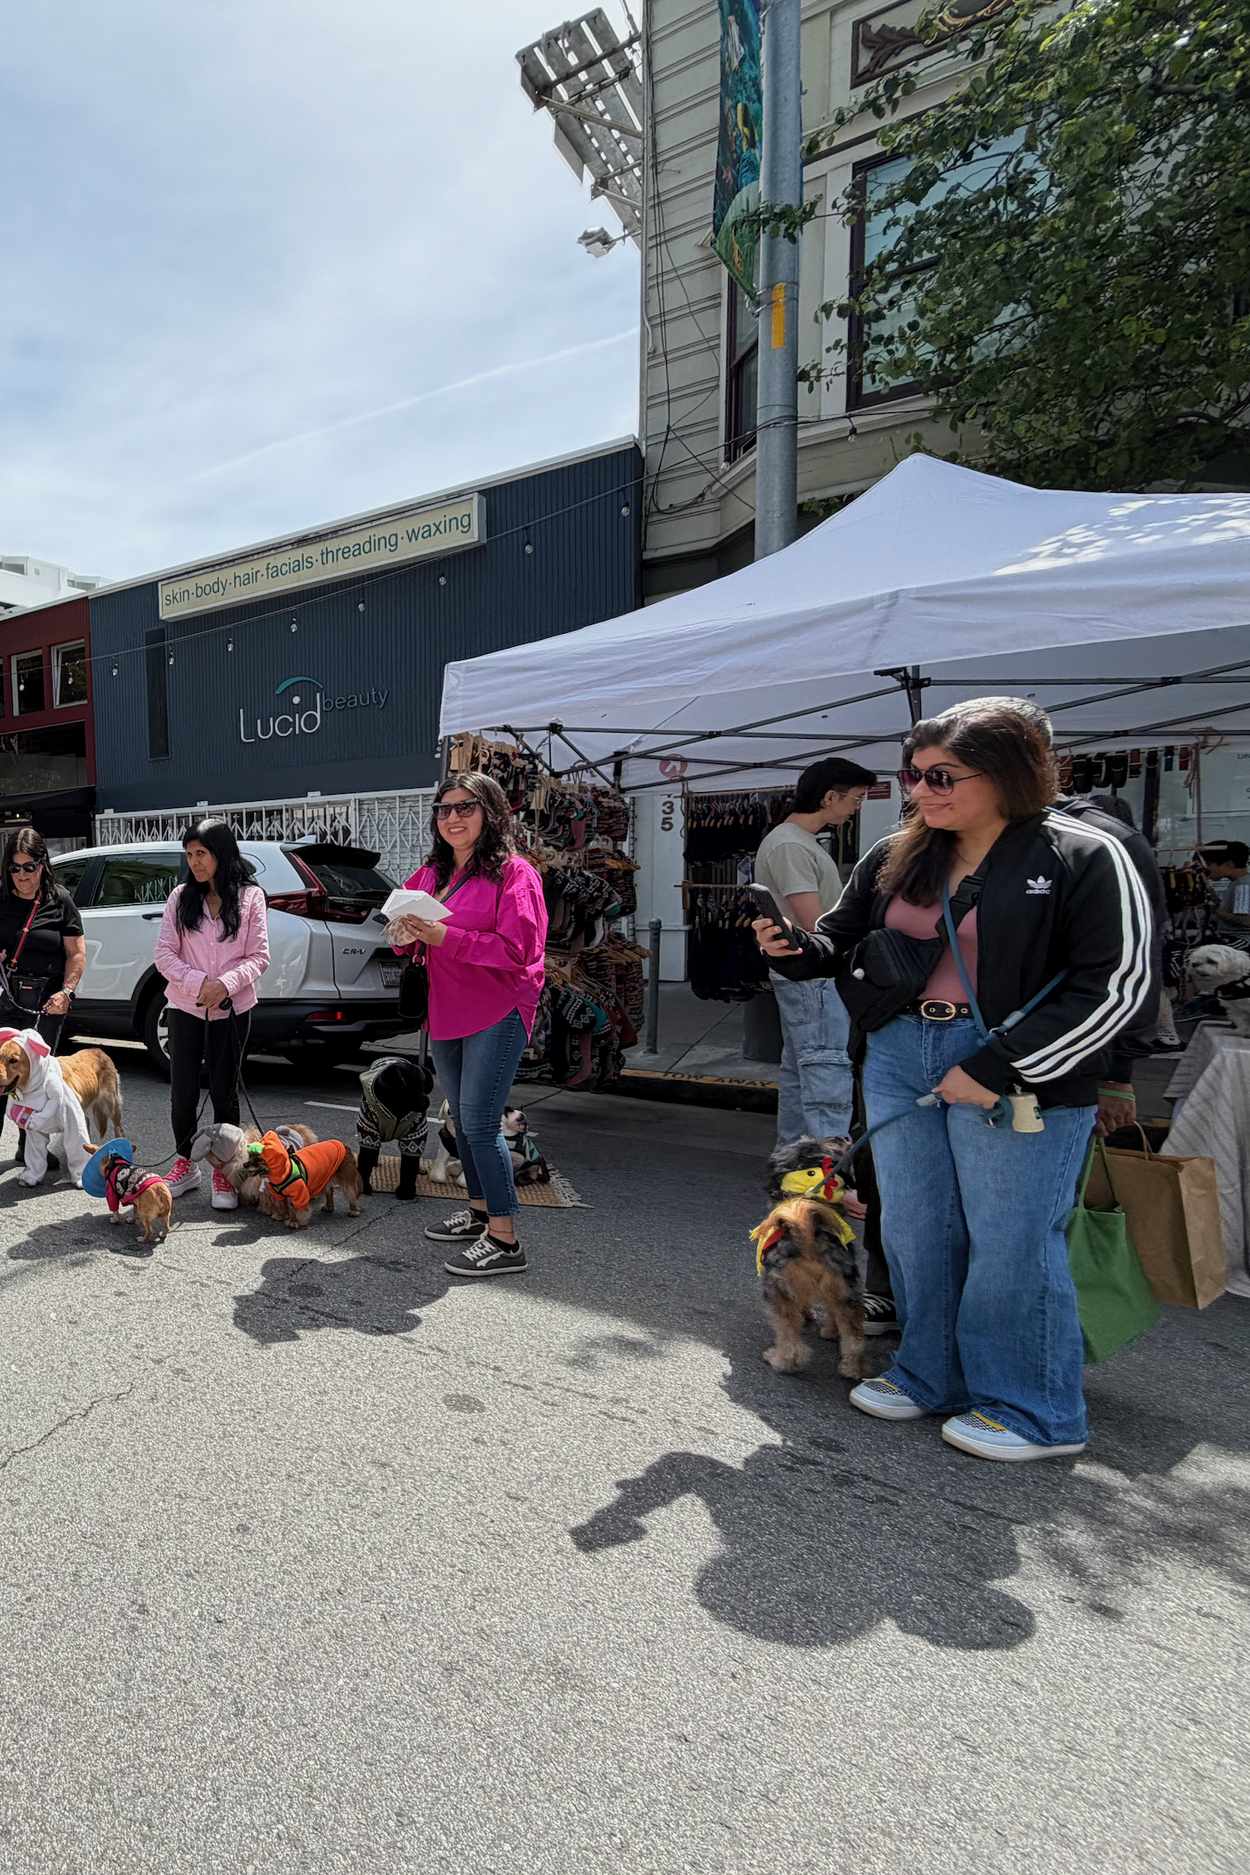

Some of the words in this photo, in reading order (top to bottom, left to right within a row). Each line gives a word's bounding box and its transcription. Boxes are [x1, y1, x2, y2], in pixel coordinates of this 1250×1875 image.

[165, 587, 190, 606] skin
[195, 577, 228, 597] body
[233, 567, 261, 588] hair
[265, 553, 314, 580] facials
[320, 532, 399, 566] threading
[406, 512, 472, 543] waxing
[240, 692, 321, 743] Lucid
[322, 687, 389, 712] beauty
[659, 793, 676, 832] 35
[713, 1077, 771, 1087] AWAY
